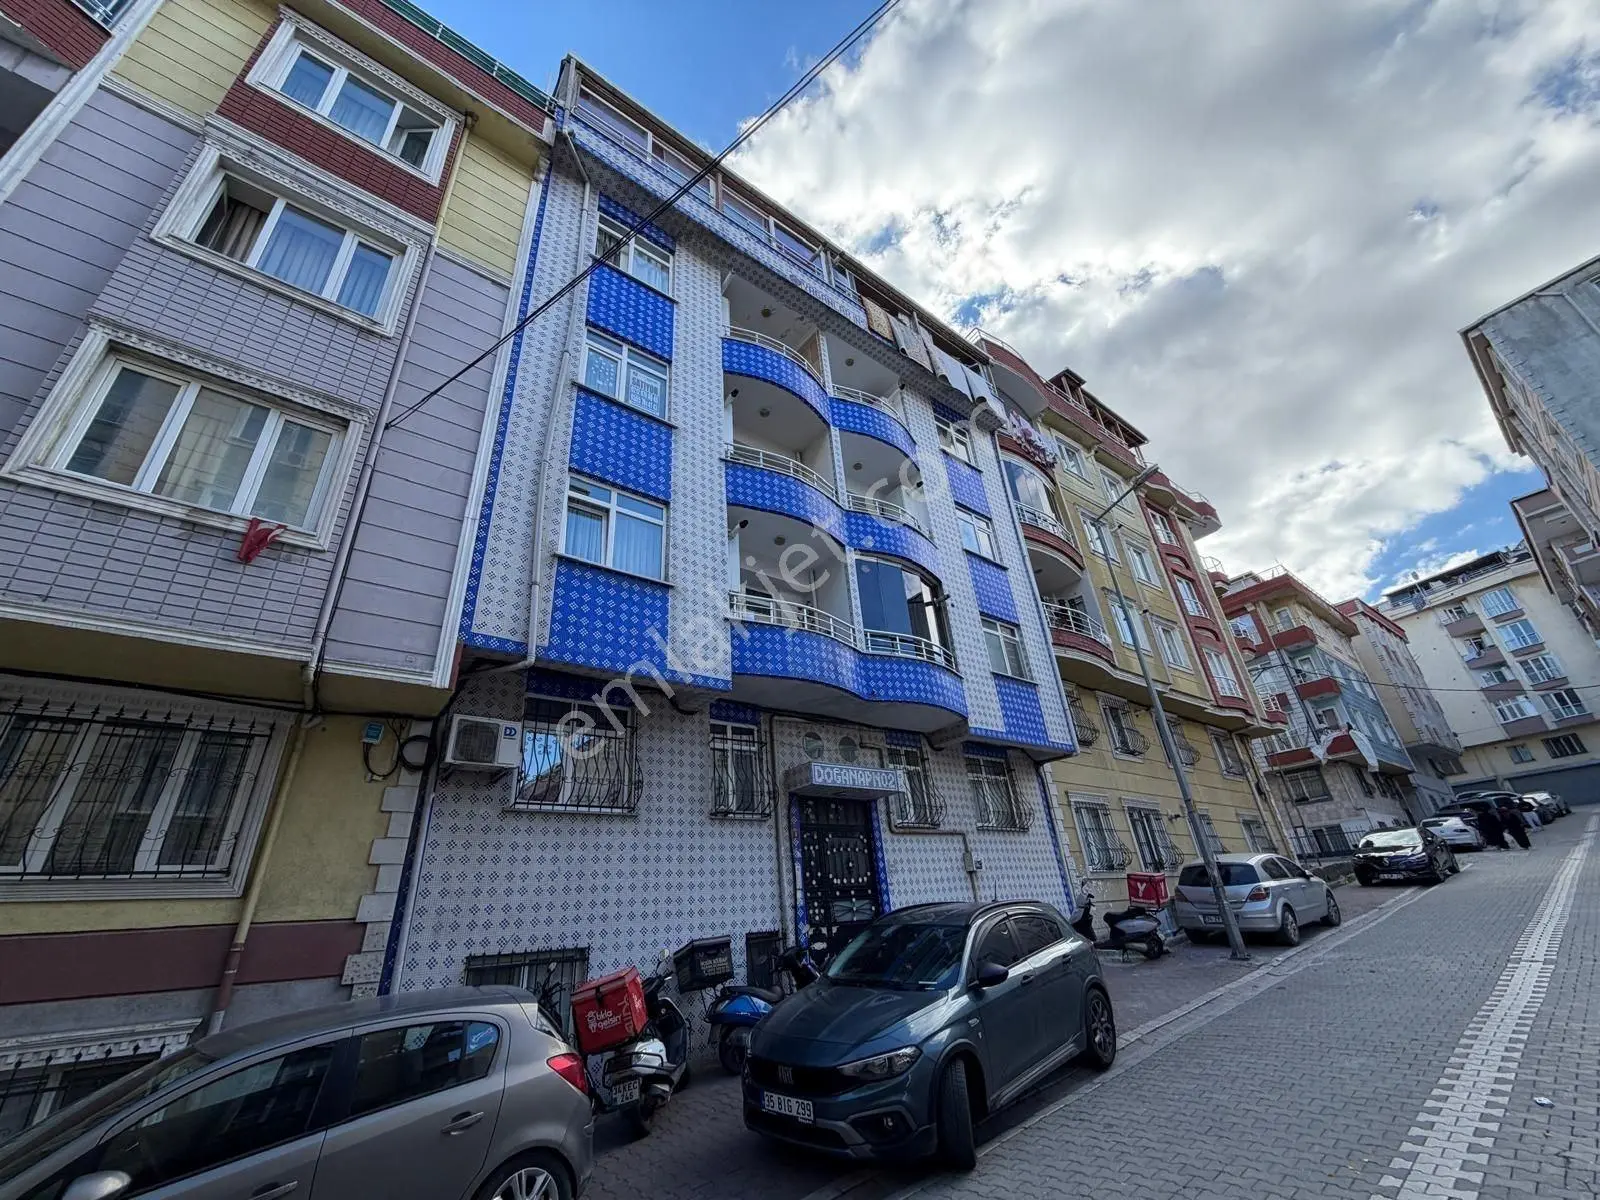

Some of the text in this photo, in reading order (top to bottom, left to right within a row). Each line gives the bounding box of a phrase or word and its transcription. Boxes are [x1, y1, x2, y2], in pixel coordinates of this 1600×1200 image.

[764, 1093, 812, 1118] 35 BIG 299
